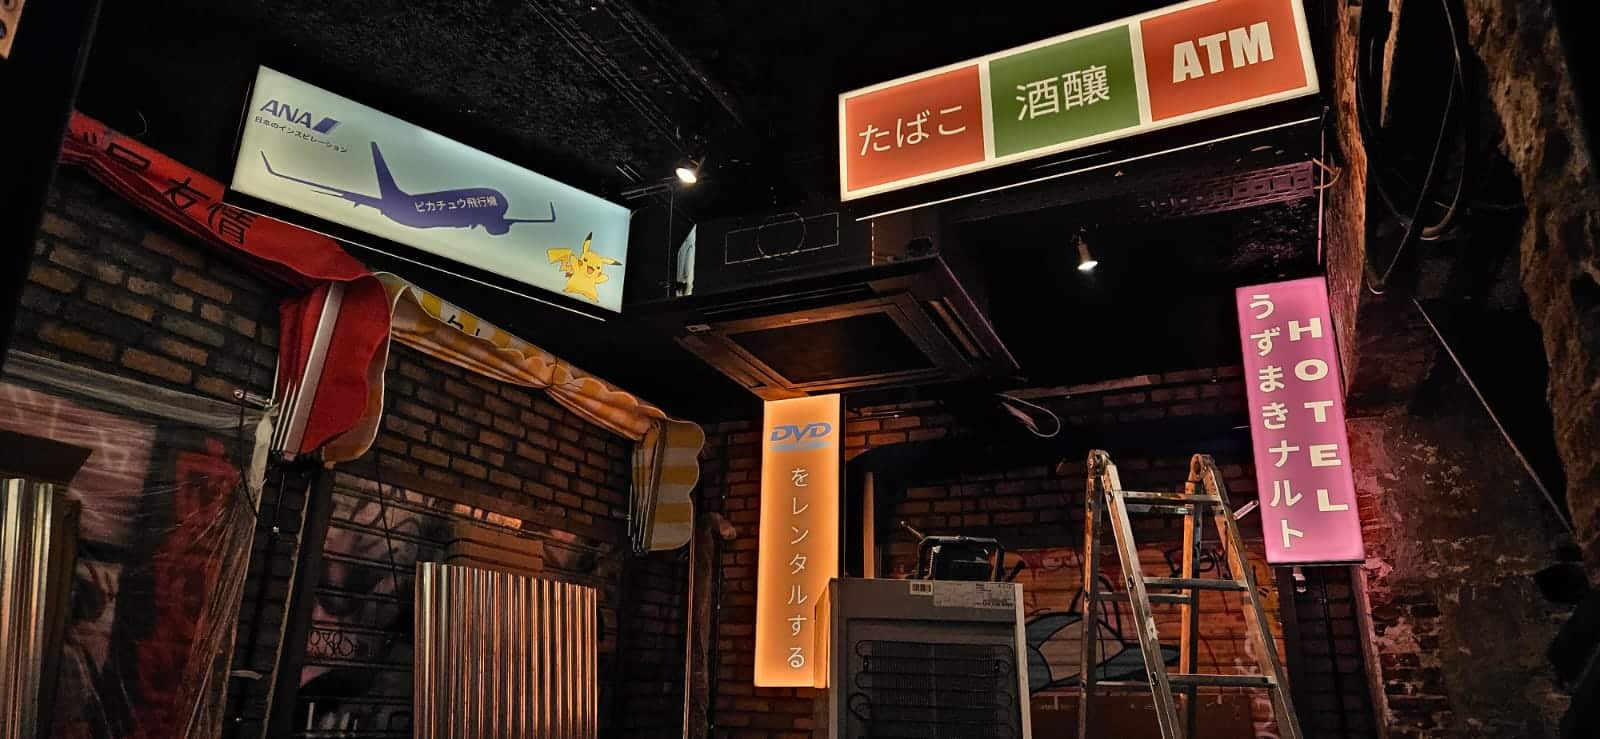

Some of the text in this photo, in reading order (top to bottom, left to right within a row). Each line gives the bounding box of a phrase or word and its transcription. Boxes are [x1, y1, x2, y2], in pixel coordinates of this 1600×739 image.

[1172, 21, 1274, 83] ATM
[260, 99, 312, 128] ANA
[858, 104, 967, 157] たばこ
[769, 421, 832, 442] DVD
[1249, 293, 1304, 549] うずまきナルト
[1288, 317, 1349, 512] HOTEL
[786, 467, 809, 669] をレンタルする
